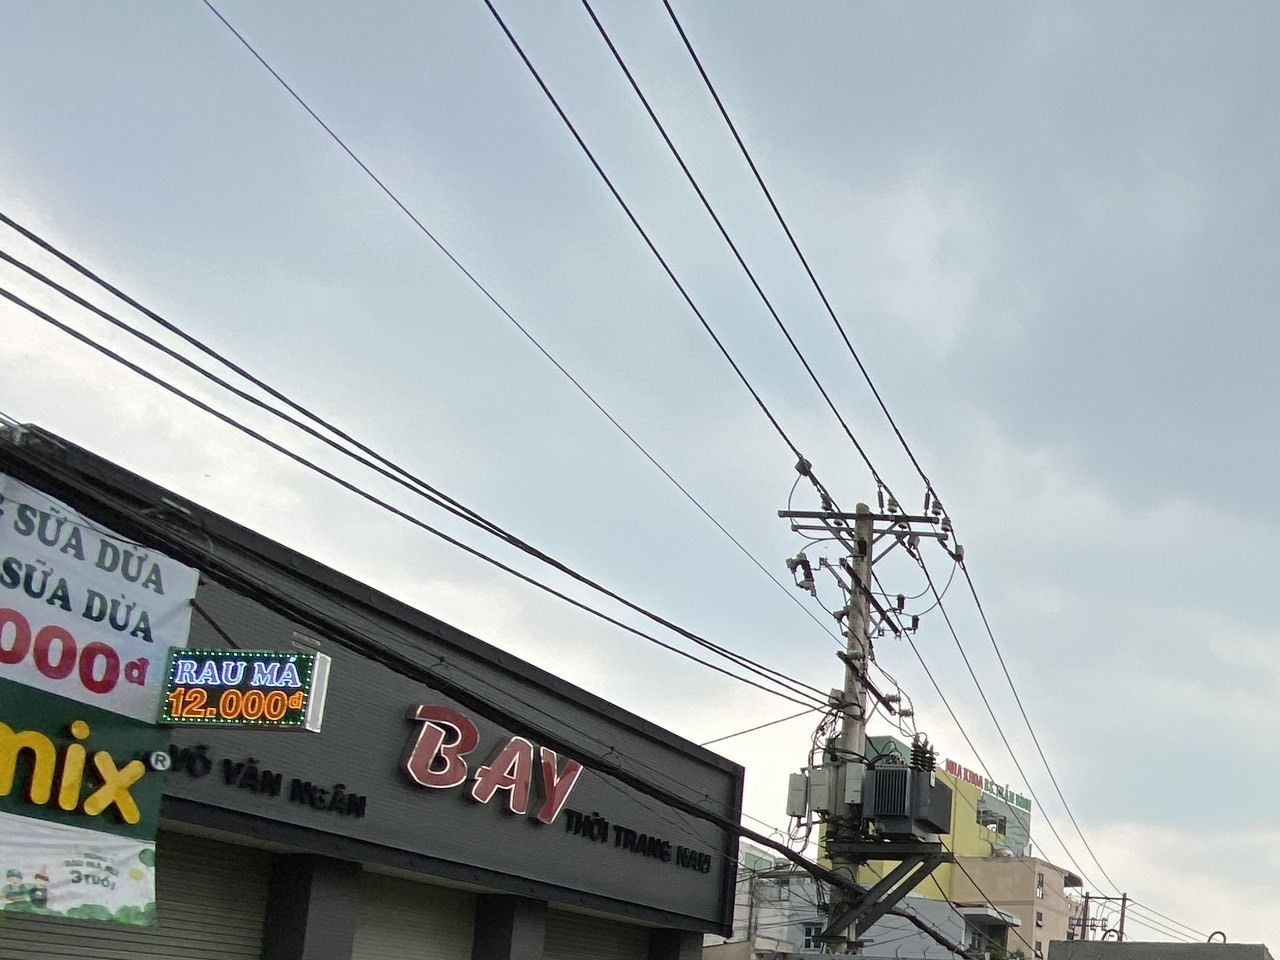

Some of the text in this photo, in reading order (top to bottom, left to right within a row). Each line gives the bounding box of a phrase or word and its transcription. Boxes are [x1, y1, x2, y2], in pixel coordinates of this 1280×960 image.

[14, 503, 85, 561] SỮA
[95, 538, 165, 596] DỪA
[0, 556, 154, 643] SỮA DỪA
[175, 656, 302, 687] RAU MÁ
[405, 704, 584, 824] BAY
[613, 824, 673, 863] TRANG
